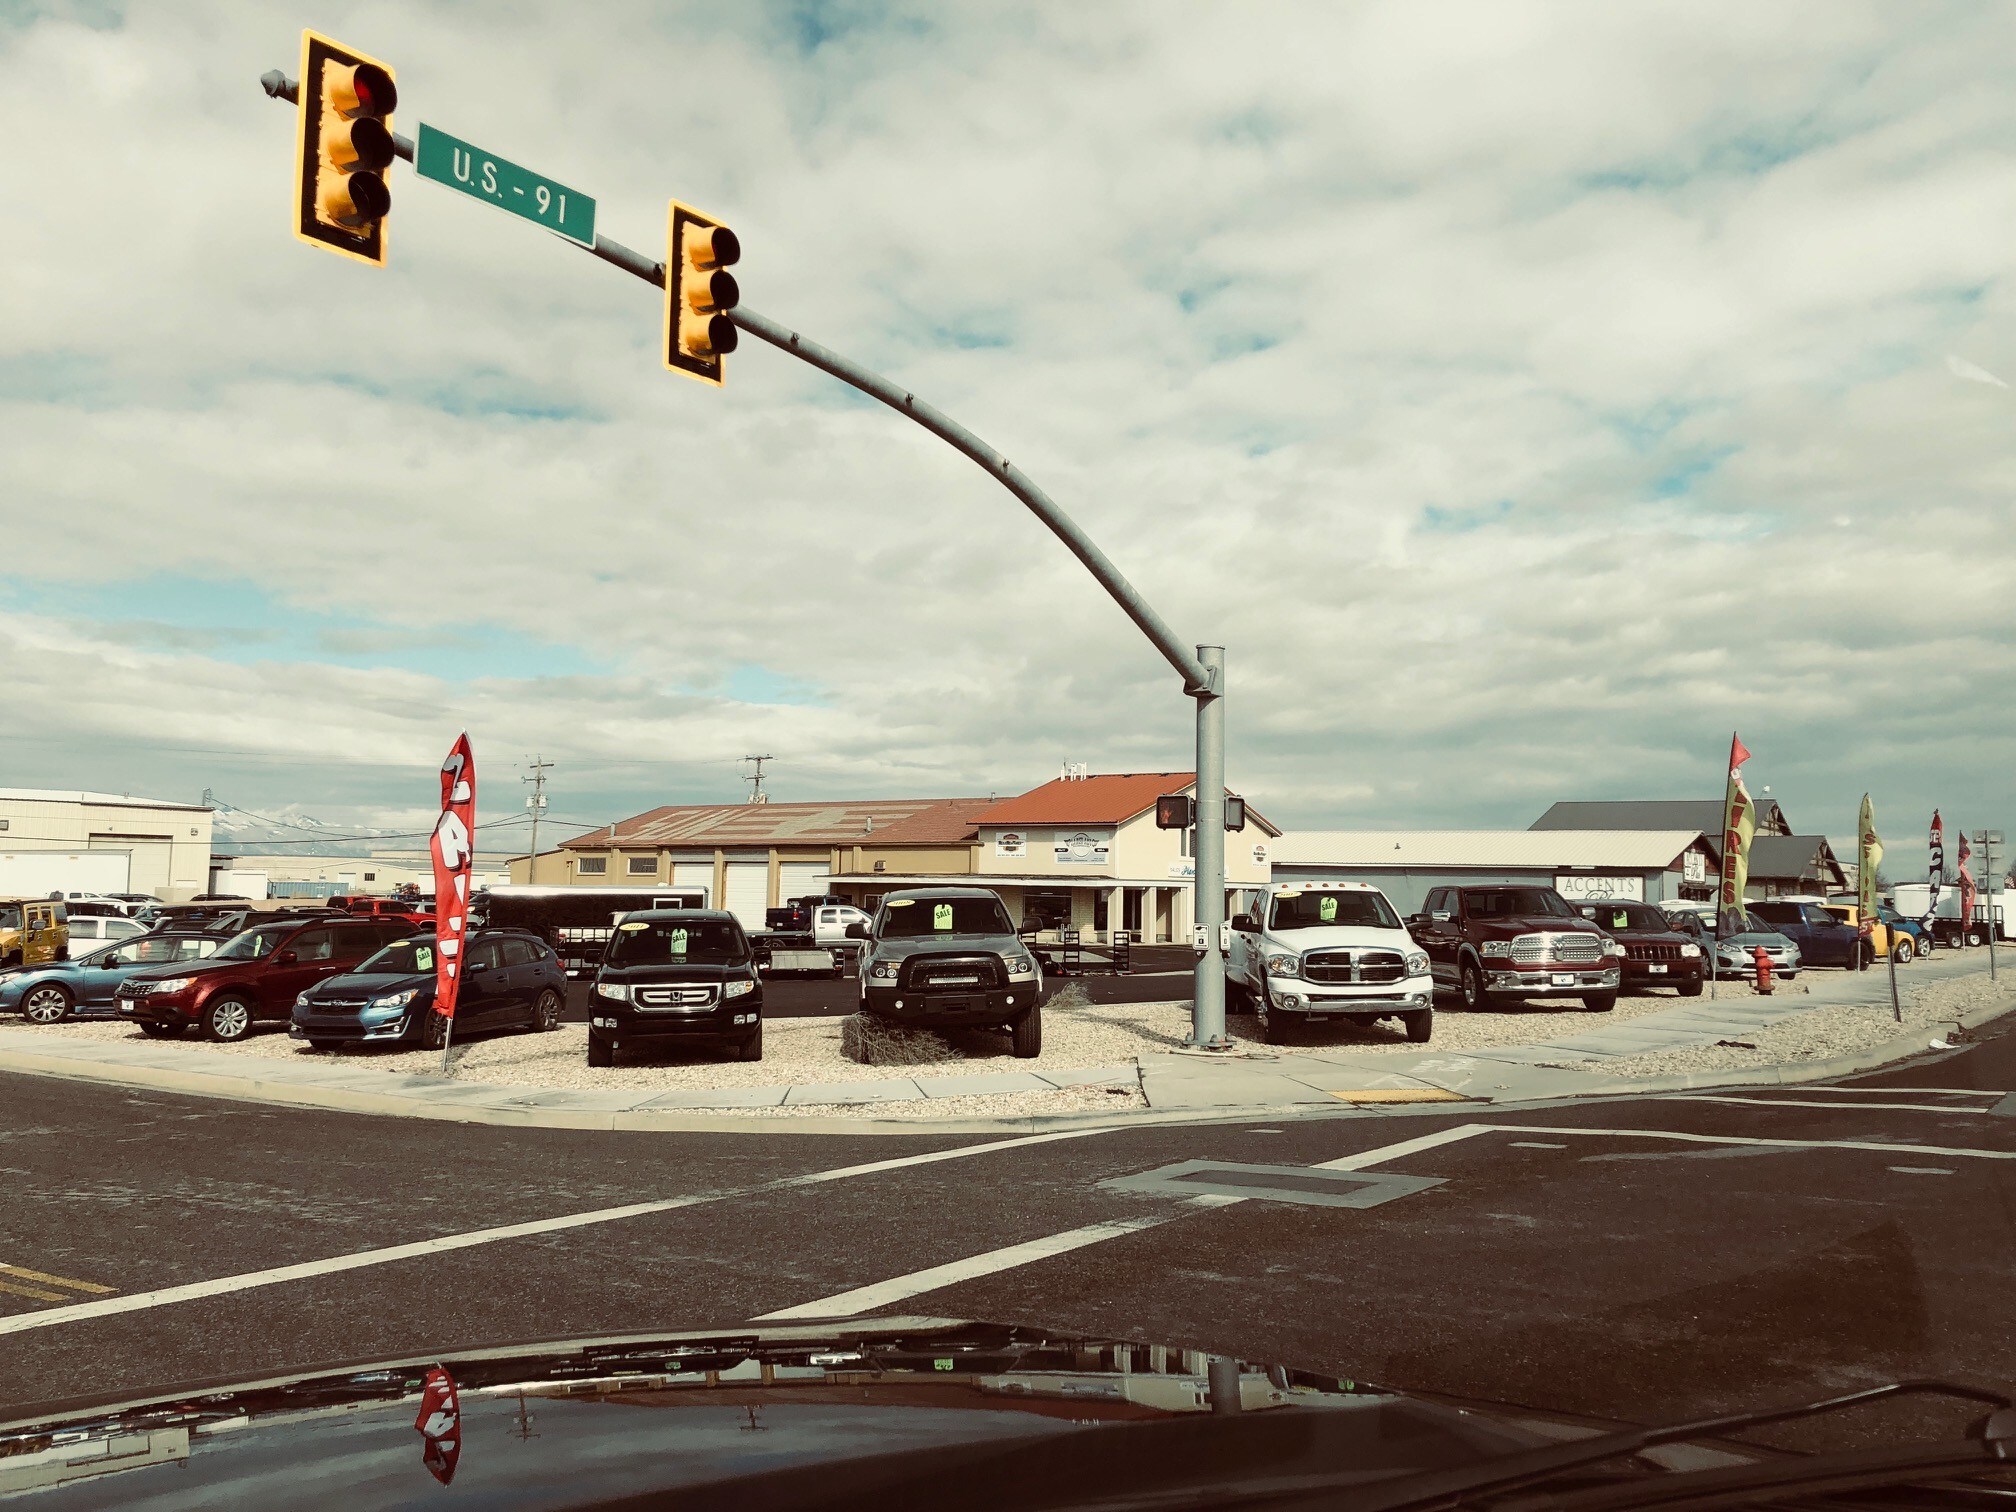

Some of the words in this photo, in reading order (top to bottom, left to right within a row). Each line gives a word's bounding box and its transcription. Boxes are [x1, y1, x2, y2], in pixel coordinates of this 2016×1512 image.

[1564, 878, 1634, 893] ACCENTS
[1322, 902, 1335, 912] SALE
[936, 908, 951, 920] SALE
[672, 933, 686, 943] SALE
[418, 951, 430, 961] SALE
